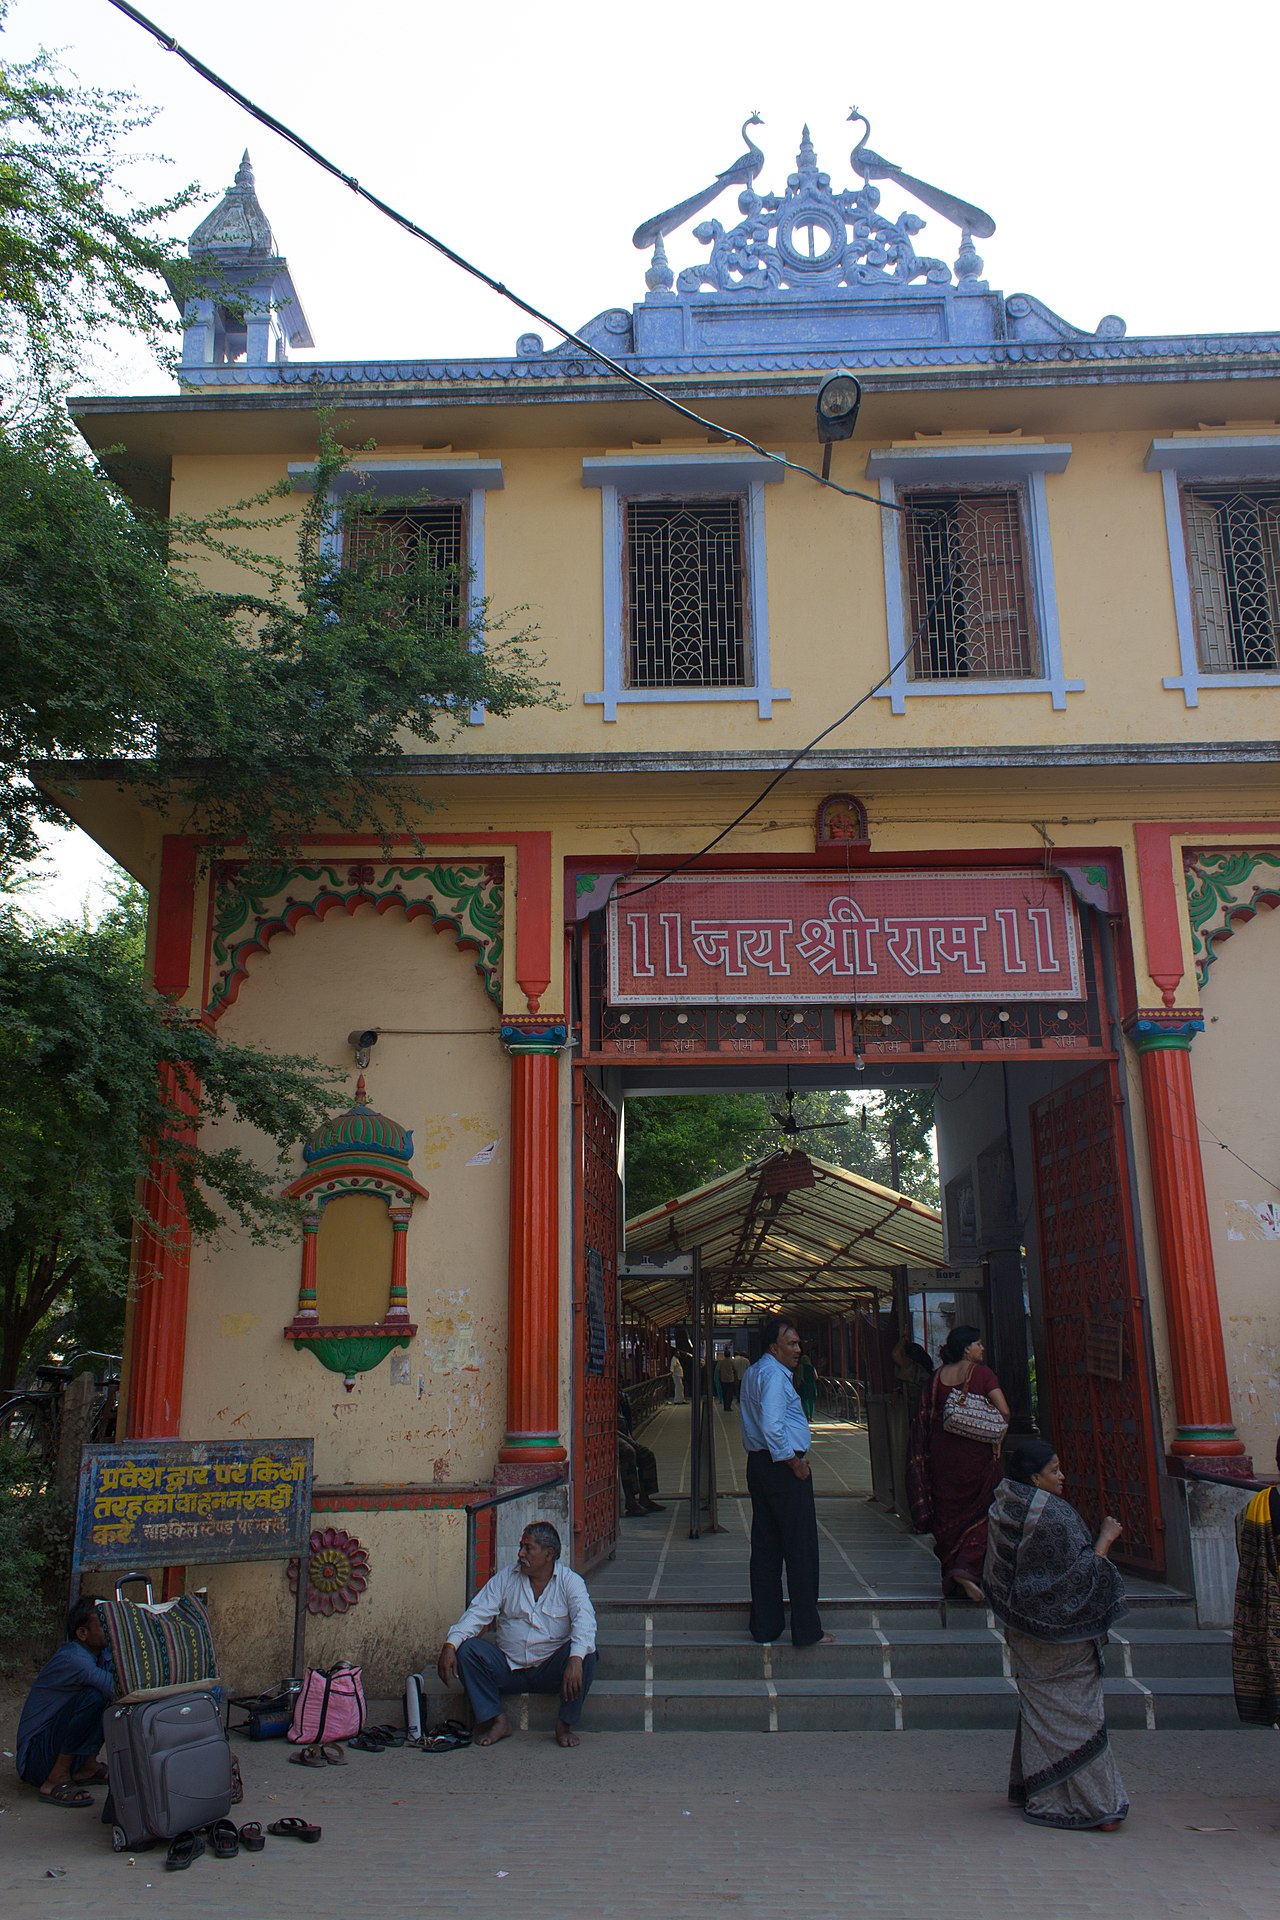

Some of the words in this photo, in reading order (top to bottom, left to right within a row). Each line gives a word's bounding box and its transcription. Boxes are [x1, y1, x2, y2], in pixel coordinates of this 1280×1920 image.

[690, 919, 793, 978] जय
[795, 895, 879, 977] श्री
[884, 916, 987, 977] राम
[936, 1271, 961, 1279] HOPE
[99, 1460, 167, 1493] प्रवेश
[166, 1465, 209, 1493] द्वार
[214, 1463, 249, 1484] पर
[250, 1455, 306, 1483] किसी
[93, 1495, 147, 1521] तरह
[144, 1493, 177, 1514] का
[175, 1491, 228, 1517] वाहन
